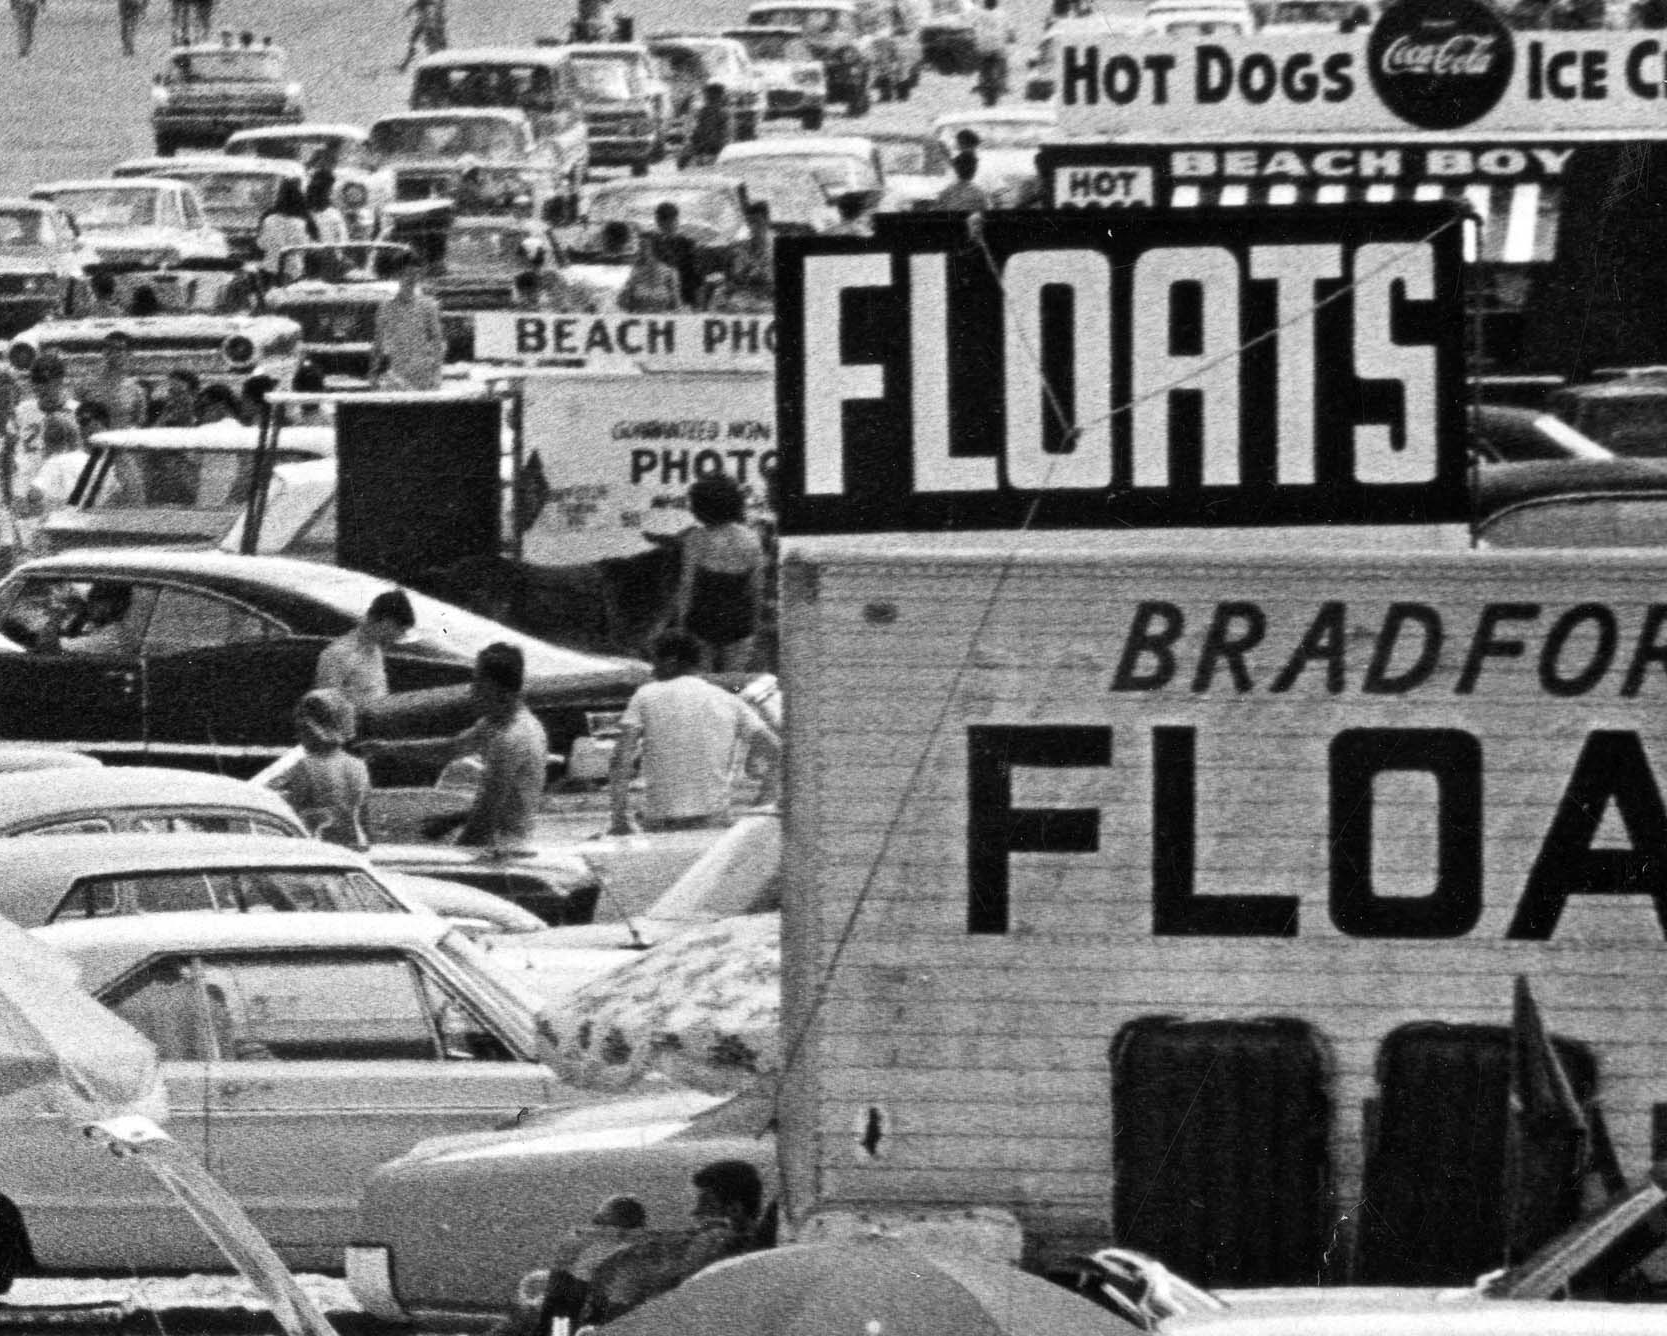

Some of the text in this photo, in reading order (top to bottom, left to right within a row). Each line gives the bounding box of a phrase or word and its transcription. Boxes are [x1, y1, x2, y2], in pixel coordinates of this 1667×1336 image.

[1062, 45, 1176, 105] HOT
[1194, 45, 1356, 105] DOGS
[1528, 40, 1608, 101] ICE
[1625, 38, 1667, 101] C
[1068, 170, 1139, 199] HOT
[1170, 148, 1575, 177] BEACH BOY
[516, 317, 675, 355] BEACH
[803, 241, 1438, 496] FLOATS
[1108, 600, 1667, 698] BRADFOR
[967, 724, 1667, 941] FLOA
